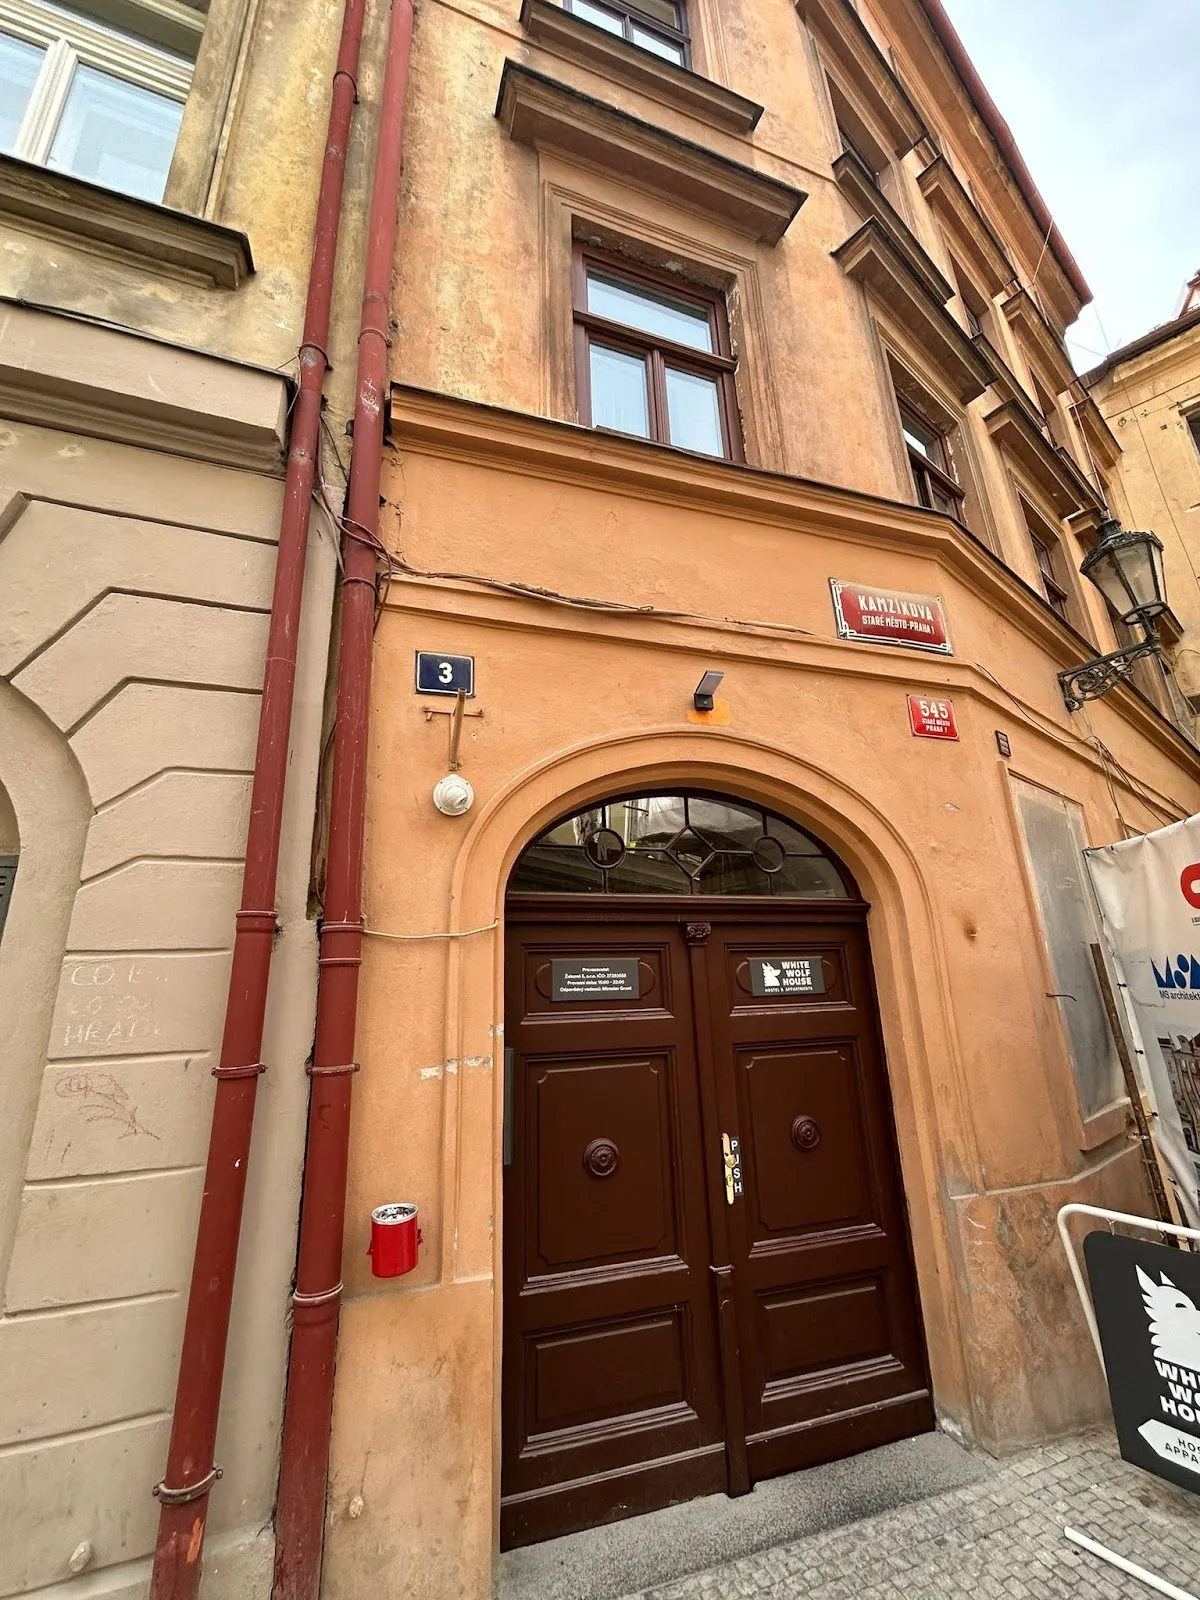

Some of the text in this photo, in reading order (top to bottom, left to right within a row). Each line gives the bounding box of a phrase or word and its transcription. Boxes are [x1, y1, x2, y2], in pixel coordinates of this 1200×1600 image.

[862, 614, 885, 626] STARÉ
[931, 625, 935, 635] 1
[439, 662, 453, 684] 3
[920, 700, 949, 720] 545
[926, 724, 944, 733] PRAHA
[781, 961, 810, 969] WHITE
[785, 969, 811, 978] WOLF
[783, 977, 812, 986] HOUSE
